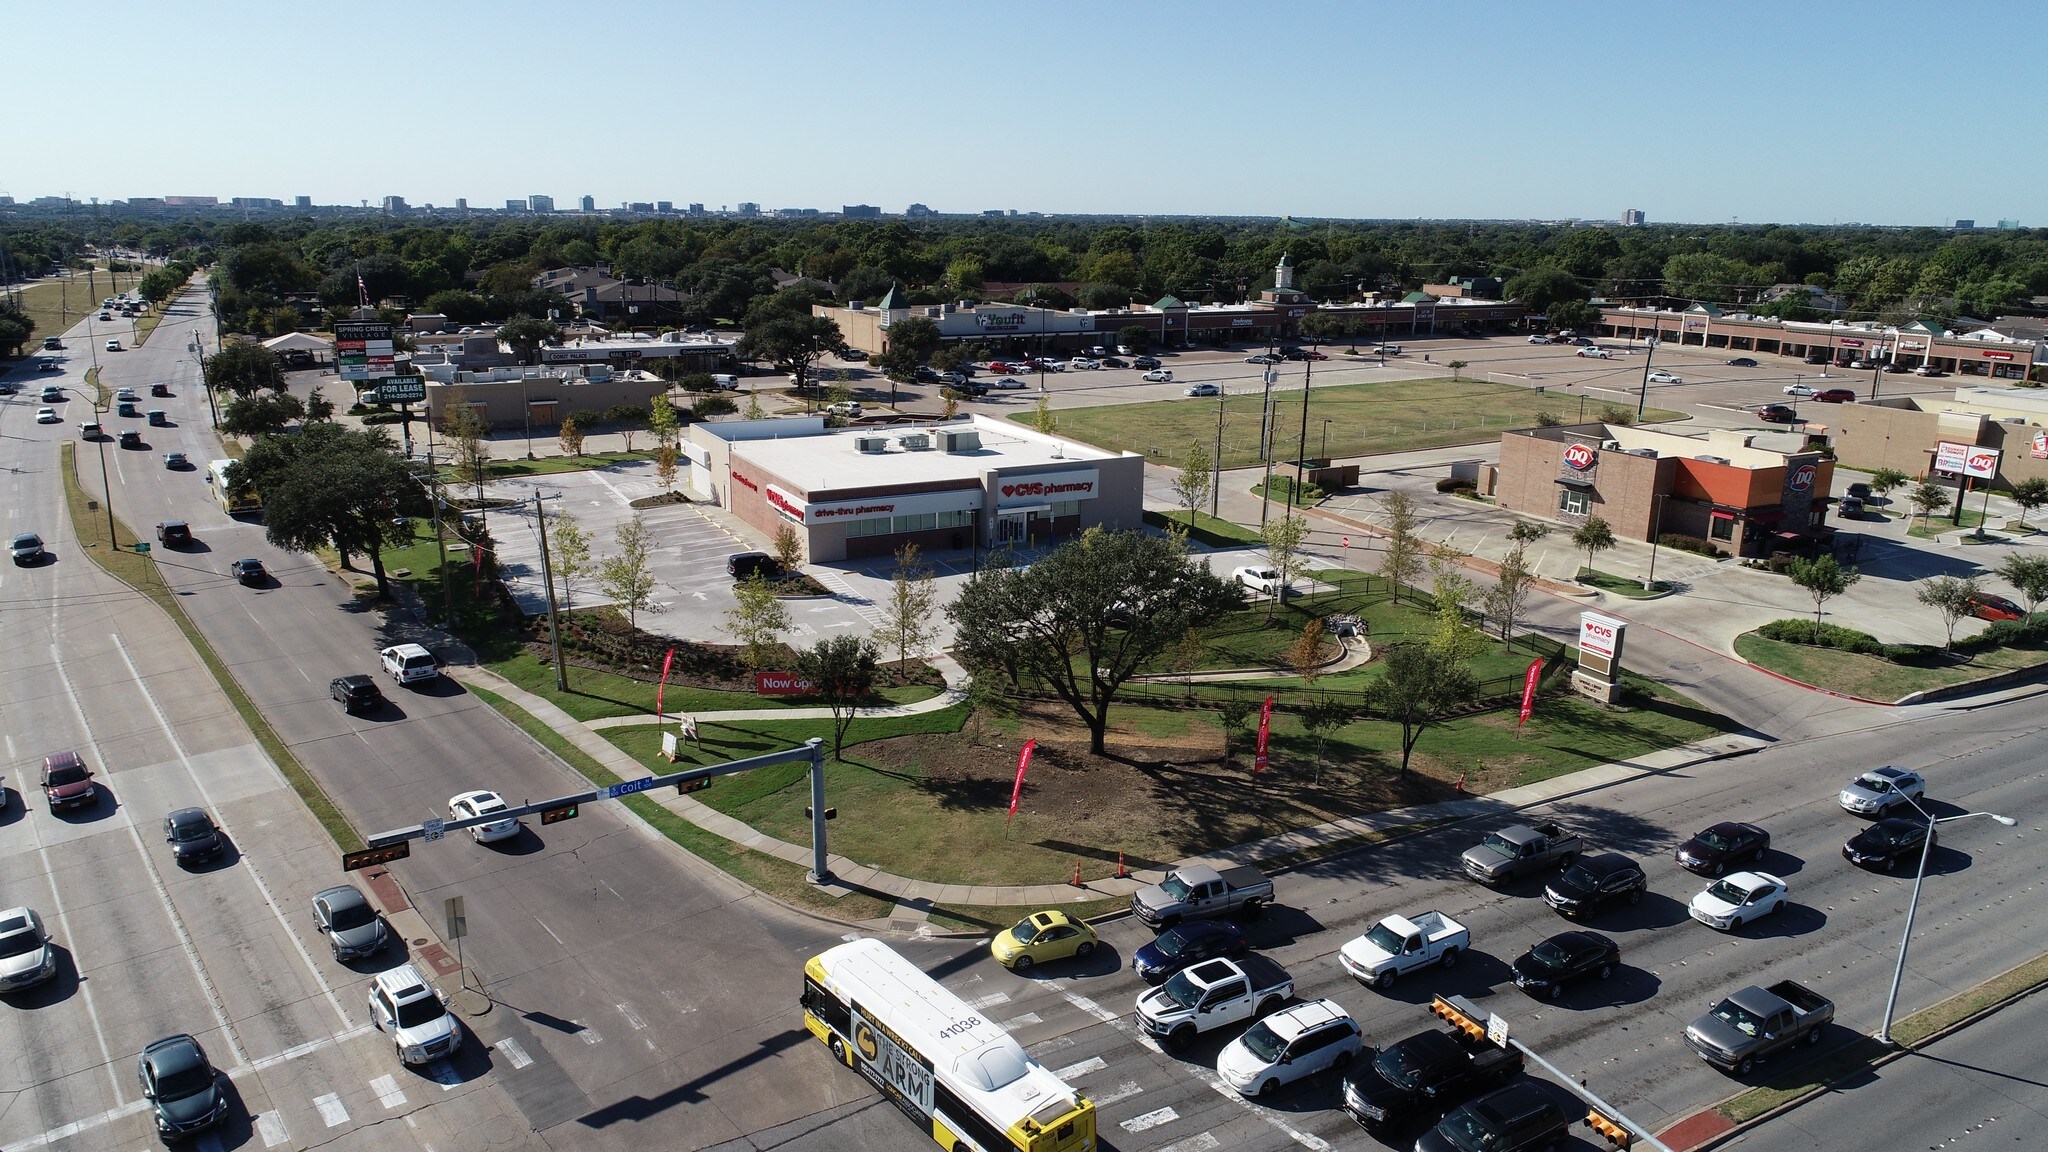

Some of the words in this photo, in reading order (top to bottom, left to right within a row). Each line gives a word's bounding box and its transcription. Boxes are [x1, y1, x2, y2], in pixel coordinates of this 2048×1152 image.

[989, 311, 1025, 325] Youfit
[1569, 449, 1588, 465] DQ
[1973, 457, 1992, 470] DQ
[1796, 471, 1813, 485] DQ
[1015, 482, 1043, 496] CVS
[1044, 482, 1093, 496] pharmacy
[815, 503, 854, 517] drive-thru
[855, 504, 894, 515] pharmacy
[1586, 632, 1610, 645] pharmacy
[1594, 625, 1612, 638] CVS
[763, 677, 790, 689] Now
[620, 780, 642, 793] Coit
[939, 1016, 981, 1040] 41038
[860, 1007, 876, 1026] HURT
[908, 1047, 923, 1064] CALL
[876, 1033, 894, 1056] THE
[896, 1048, 930, 1086] STRONG
[883, 1053, 924, 1107] ARM
